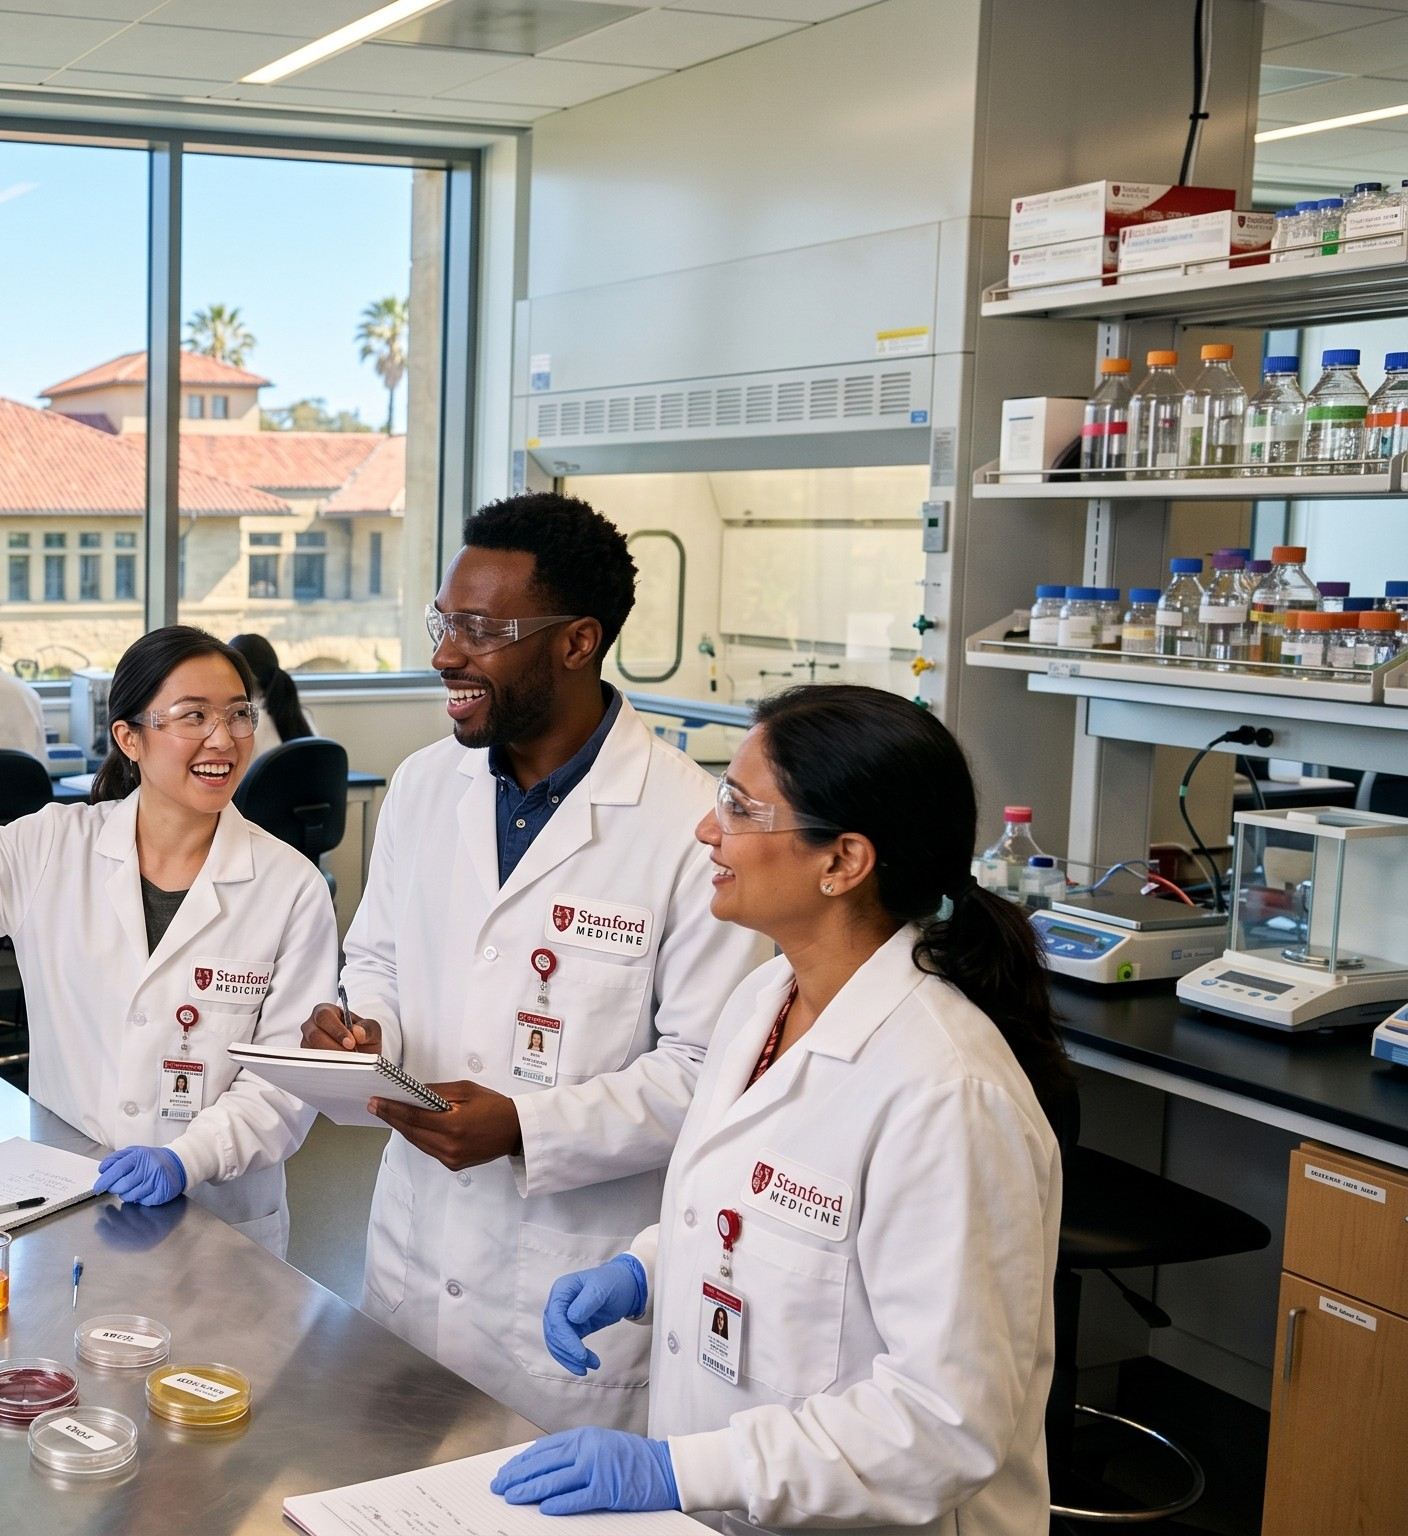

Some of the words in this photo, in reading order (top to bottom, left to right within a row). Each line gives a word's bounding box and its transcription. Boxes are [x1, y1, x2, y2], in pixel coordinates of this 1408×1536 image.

[576, 925, 643, 946] MEDICINE
[577, 910, 645, 934] Stanford
[774, 1172, 843, 1213] Stanford
[769, 1190, 841, 1227] MEDICINE
